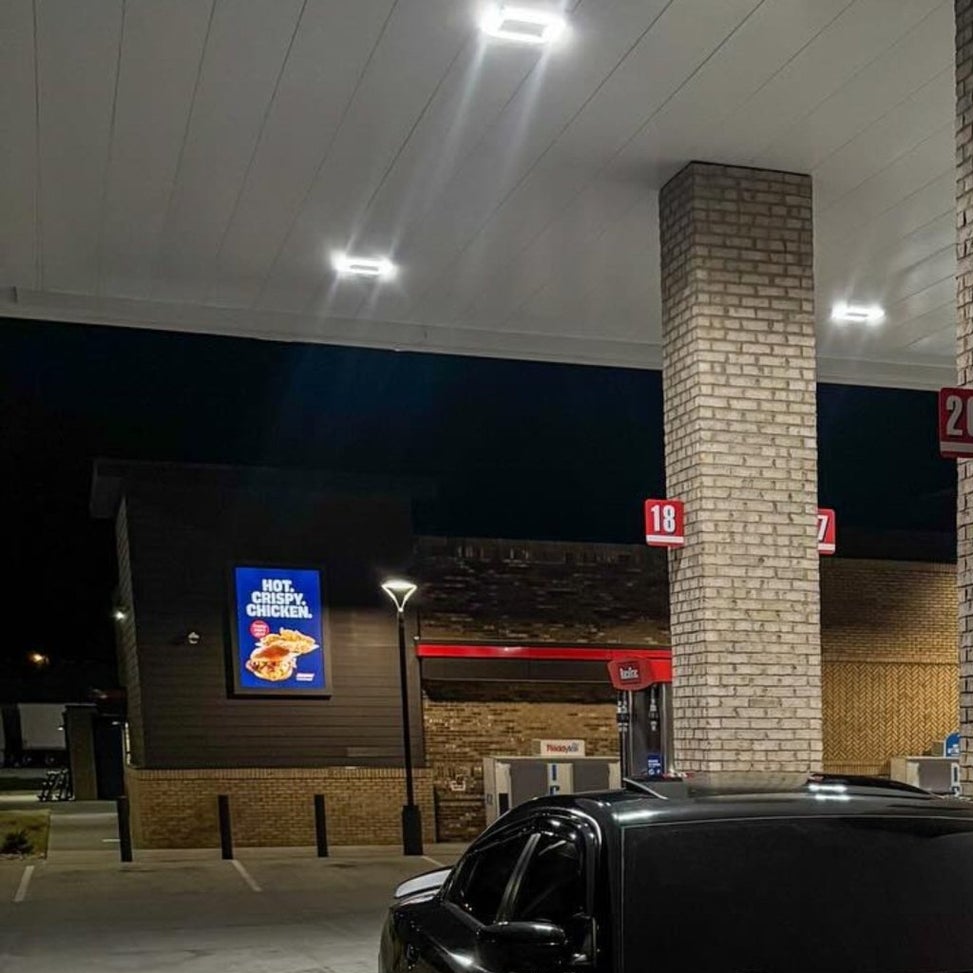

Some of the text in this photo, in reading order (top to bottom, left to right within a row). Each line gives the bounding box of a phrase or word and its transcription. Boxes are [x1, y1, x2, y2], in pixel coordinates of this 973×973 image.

[650, 504, 676, 533] 18
[817, 514, 829, 541] 7
[261, 579, 295, 592] HOT.
[251, 591, 306, 606] CRISPY.
[245, 604, 313, 619] CHICKEN.
